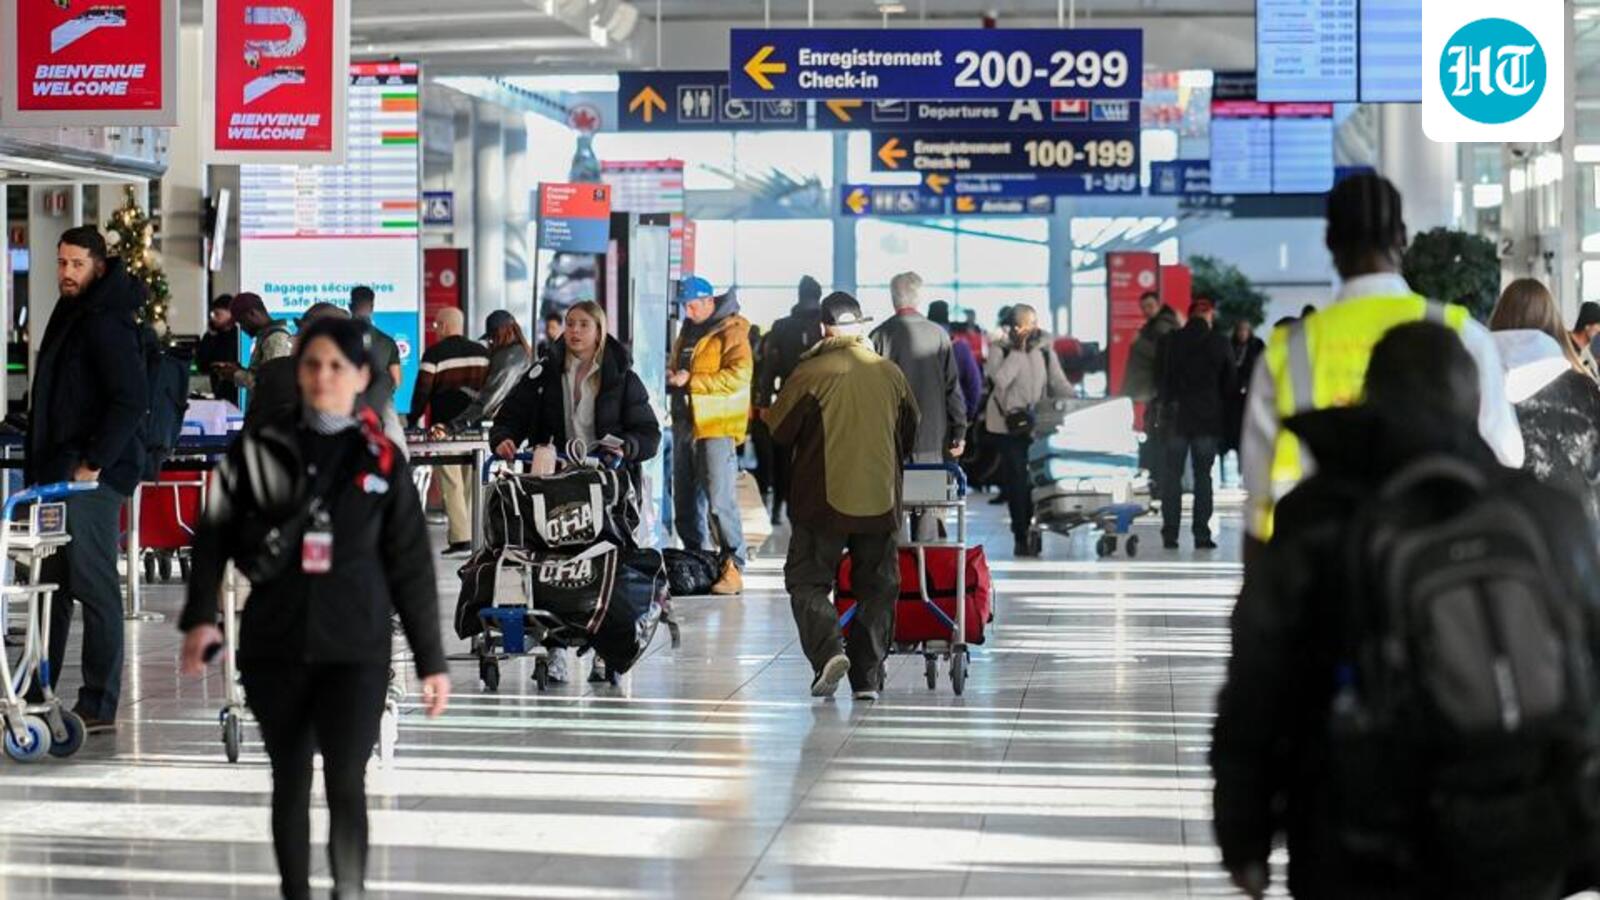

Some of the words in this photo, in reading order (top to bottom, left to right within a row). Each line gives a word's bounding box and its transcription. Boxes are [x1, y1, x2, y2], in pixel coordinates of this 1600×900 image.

[798, 48, 943, 69] Enregistrement
[35, 64, 146, 79] BIENVENUE
[954, 50, 1129, 89] 200-299
[798, 71, 879, 89] Check-in
[33, 81, 129, 96] WELCOME
[918, 104, 999, 120] Departures
[1008, 97, 1044, 122] A
[230, 113, 321, 126] BIENVENUE
[228, 127, 307, 140] WELCOME
[1024, 139, 1135, 168] 100-199
[264, 283, 318, 295] Bagages
